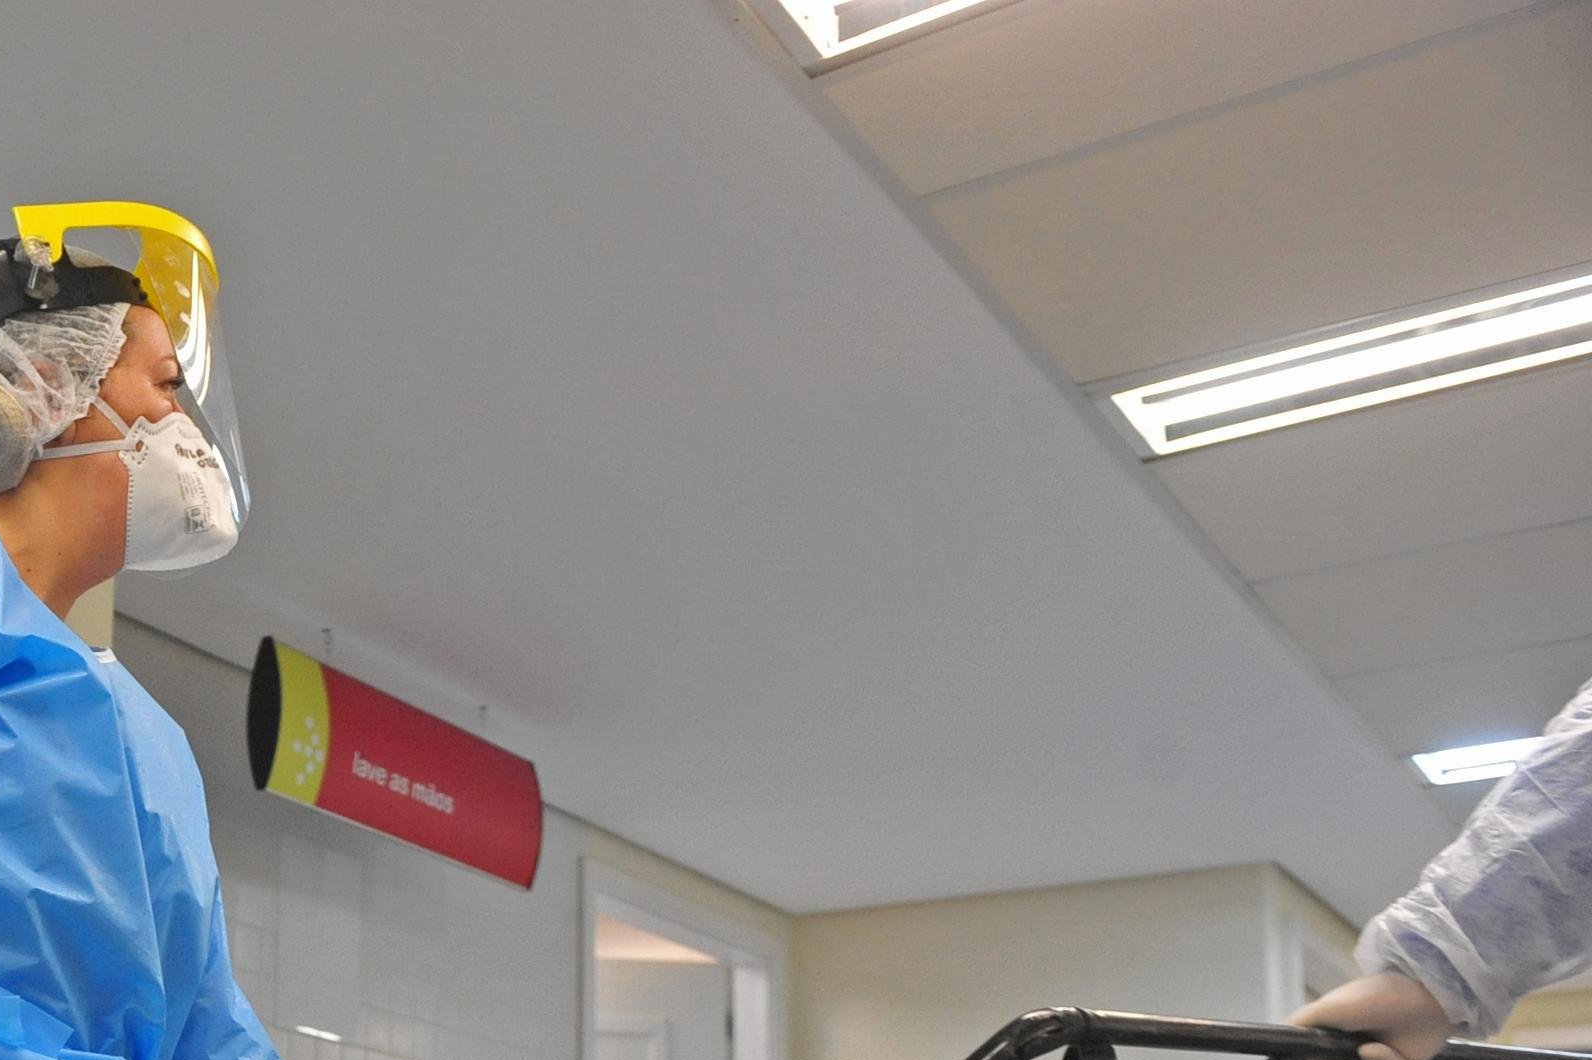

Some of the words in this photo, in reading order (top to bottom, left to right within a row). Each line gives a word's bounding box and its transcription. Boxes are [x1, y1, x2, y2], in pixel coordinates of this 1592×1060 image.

[352, 750, 388, 787] lave
[388, 772, 409, 796] as
[411, 782, 455, 815] mãos
